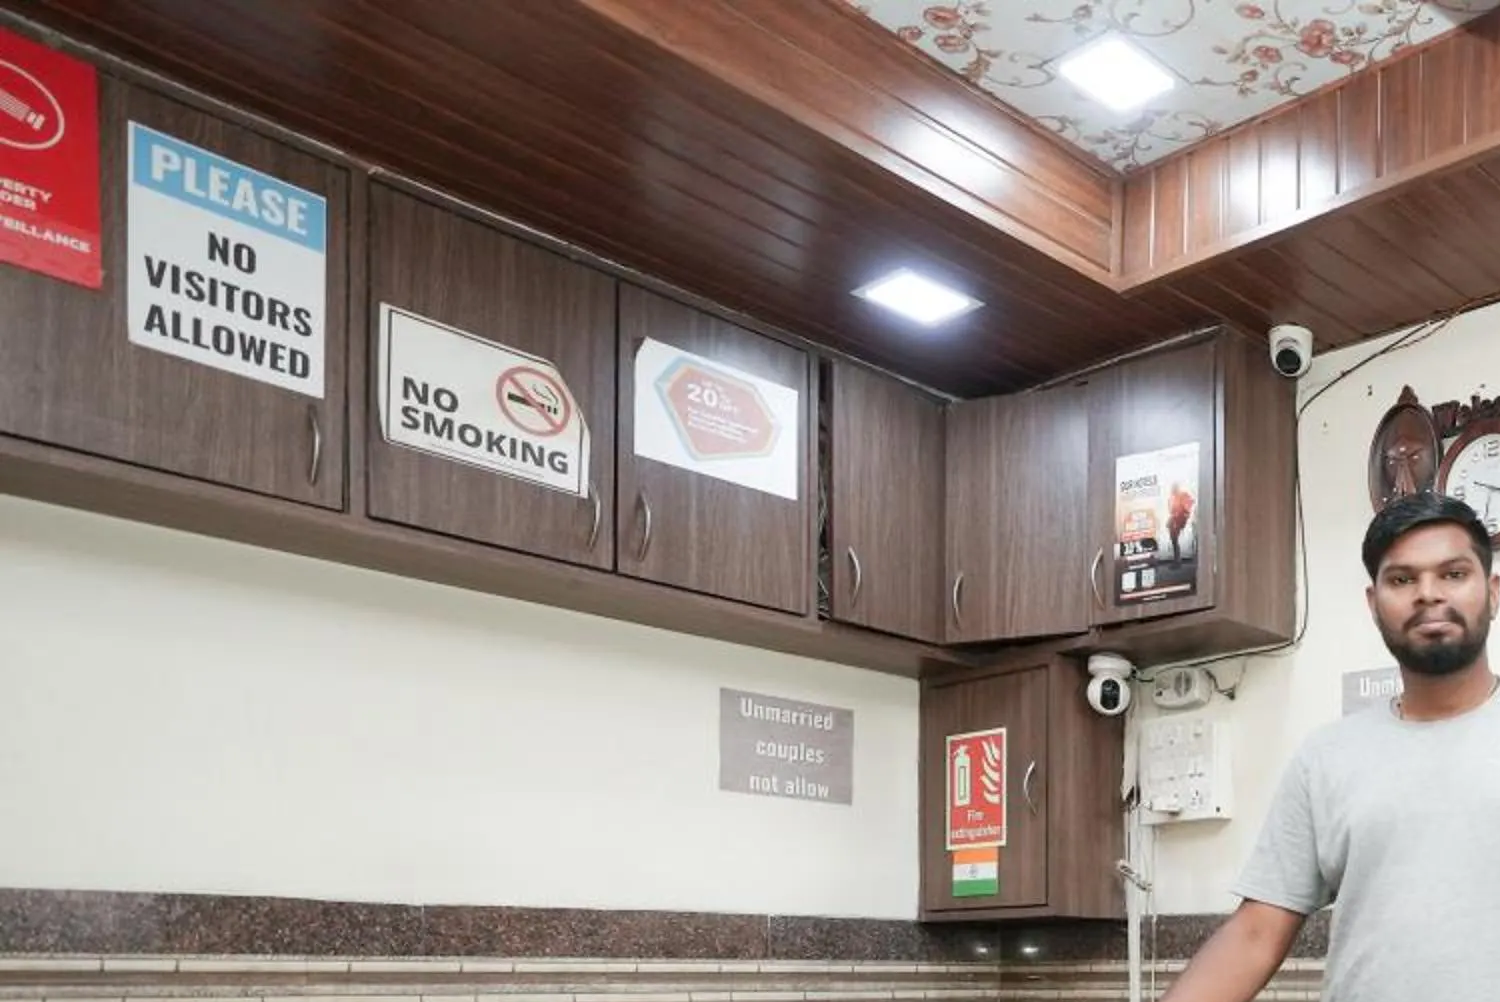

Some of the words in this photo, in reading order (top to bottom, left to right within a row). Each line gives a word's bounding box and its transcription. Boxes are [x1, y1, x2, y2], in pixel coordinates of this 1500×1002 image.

[151, 144, 308, 236] PLEASE
[207, 231, 257, 275] NO
[144, 255, 312, 337] VISITORS
[144, 304, 310, 379] ALLOWED
[402, 376, 459, 413] NO
[401, 405, 569, 475] SMOKING
[740, 697, 834, 731] Unmarried
[755, 740, 825, 763] couples
[749, 775, 778, 793] not
[785, 776, 829, 798] allow
